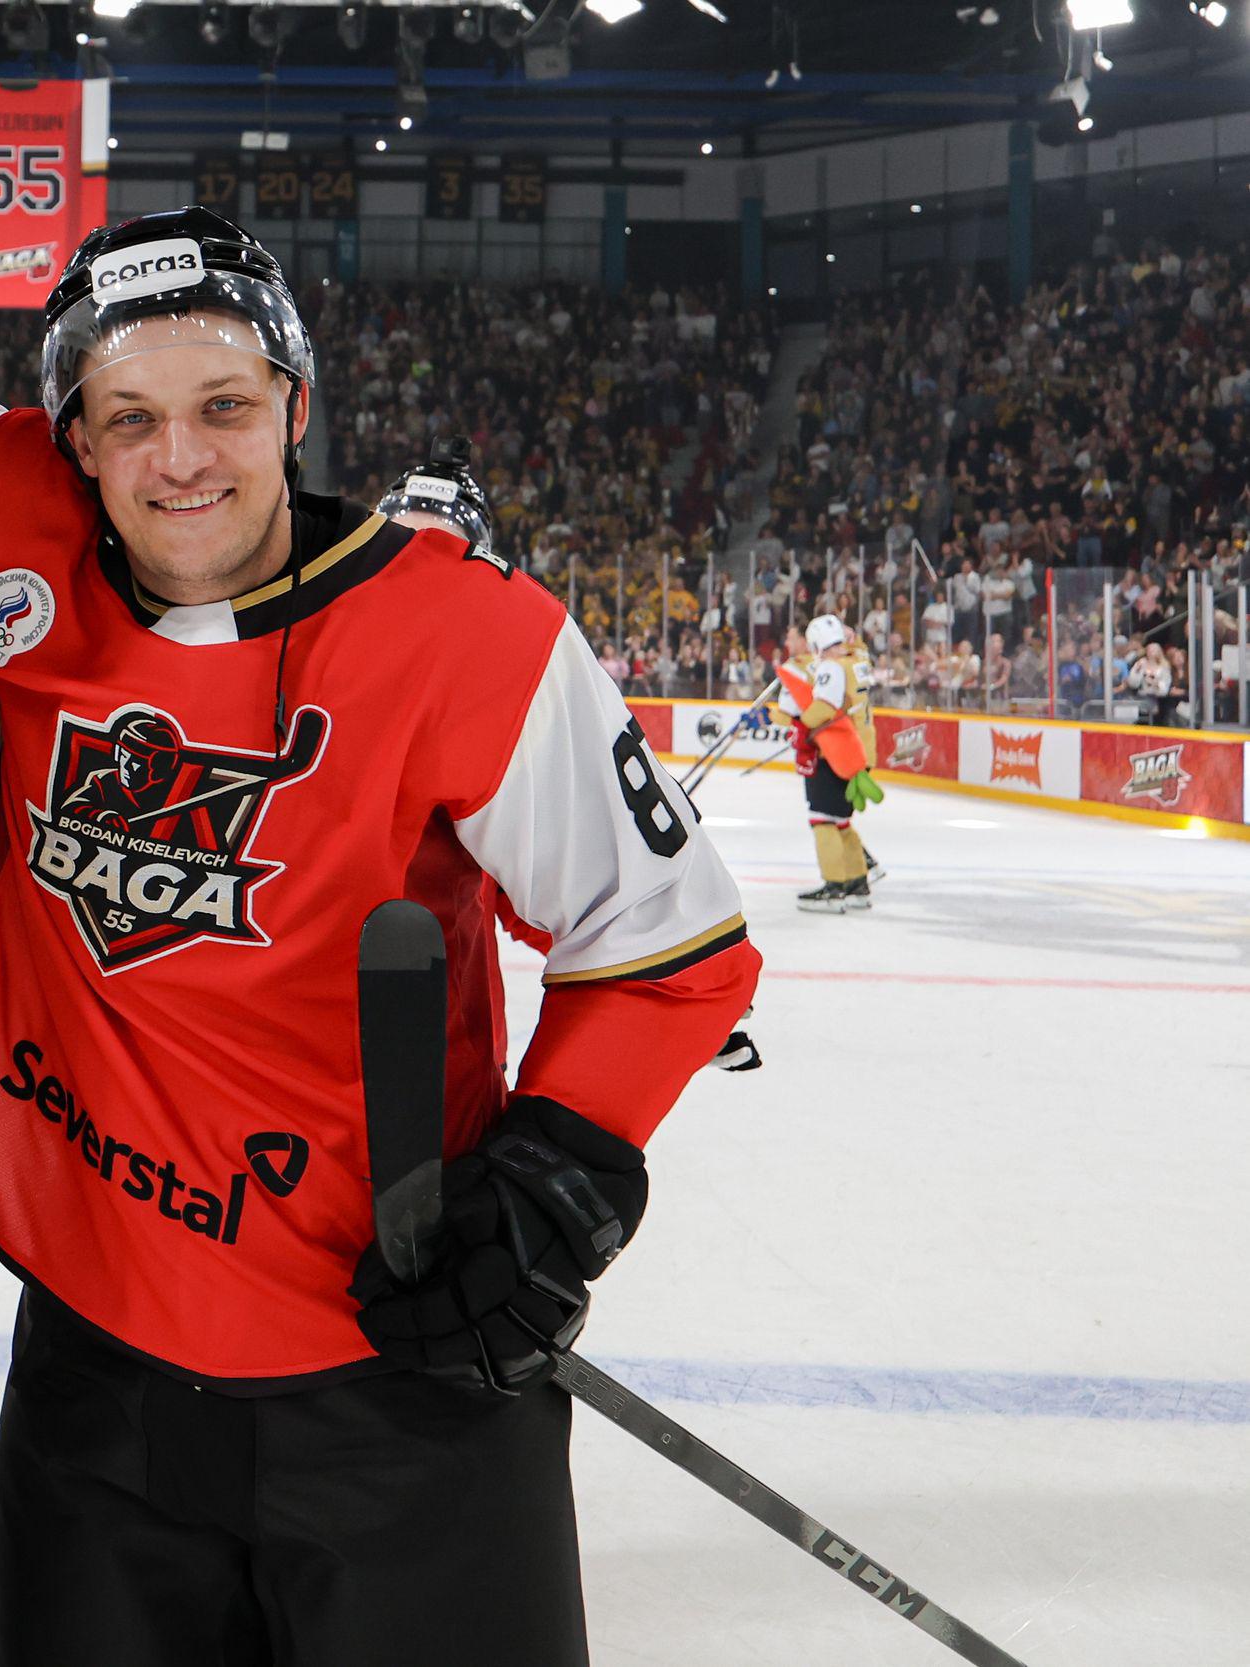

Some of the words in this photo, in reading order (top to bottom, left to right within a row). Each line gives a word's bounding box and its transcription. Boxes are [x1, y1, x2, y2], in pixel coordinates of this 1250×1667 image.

[198, 173, 238, 203] 17
[258, 172, 300, 201] 20
[311, 171, 355, 200] 24
[439, 172, 461, 201] 3
[504, 174, 544, 203] 35
[27, 577, 50, 613] КОМИТЕТ
[21, 614, 49, 646] РОССИИ
[1132, 750, 1178, 784] BAGA
[612, 714, 702, 859] 8
[58, 816, 125, 848] BOGDAN
[127, 836, 228, 868] KISELEVICH
[37, 826, 243, 929] BAGA
[102, 908, 137, 934] 55
[0, 1039, 249, 1245] Severstal
[810, 1527, 929, 1621] CCM
